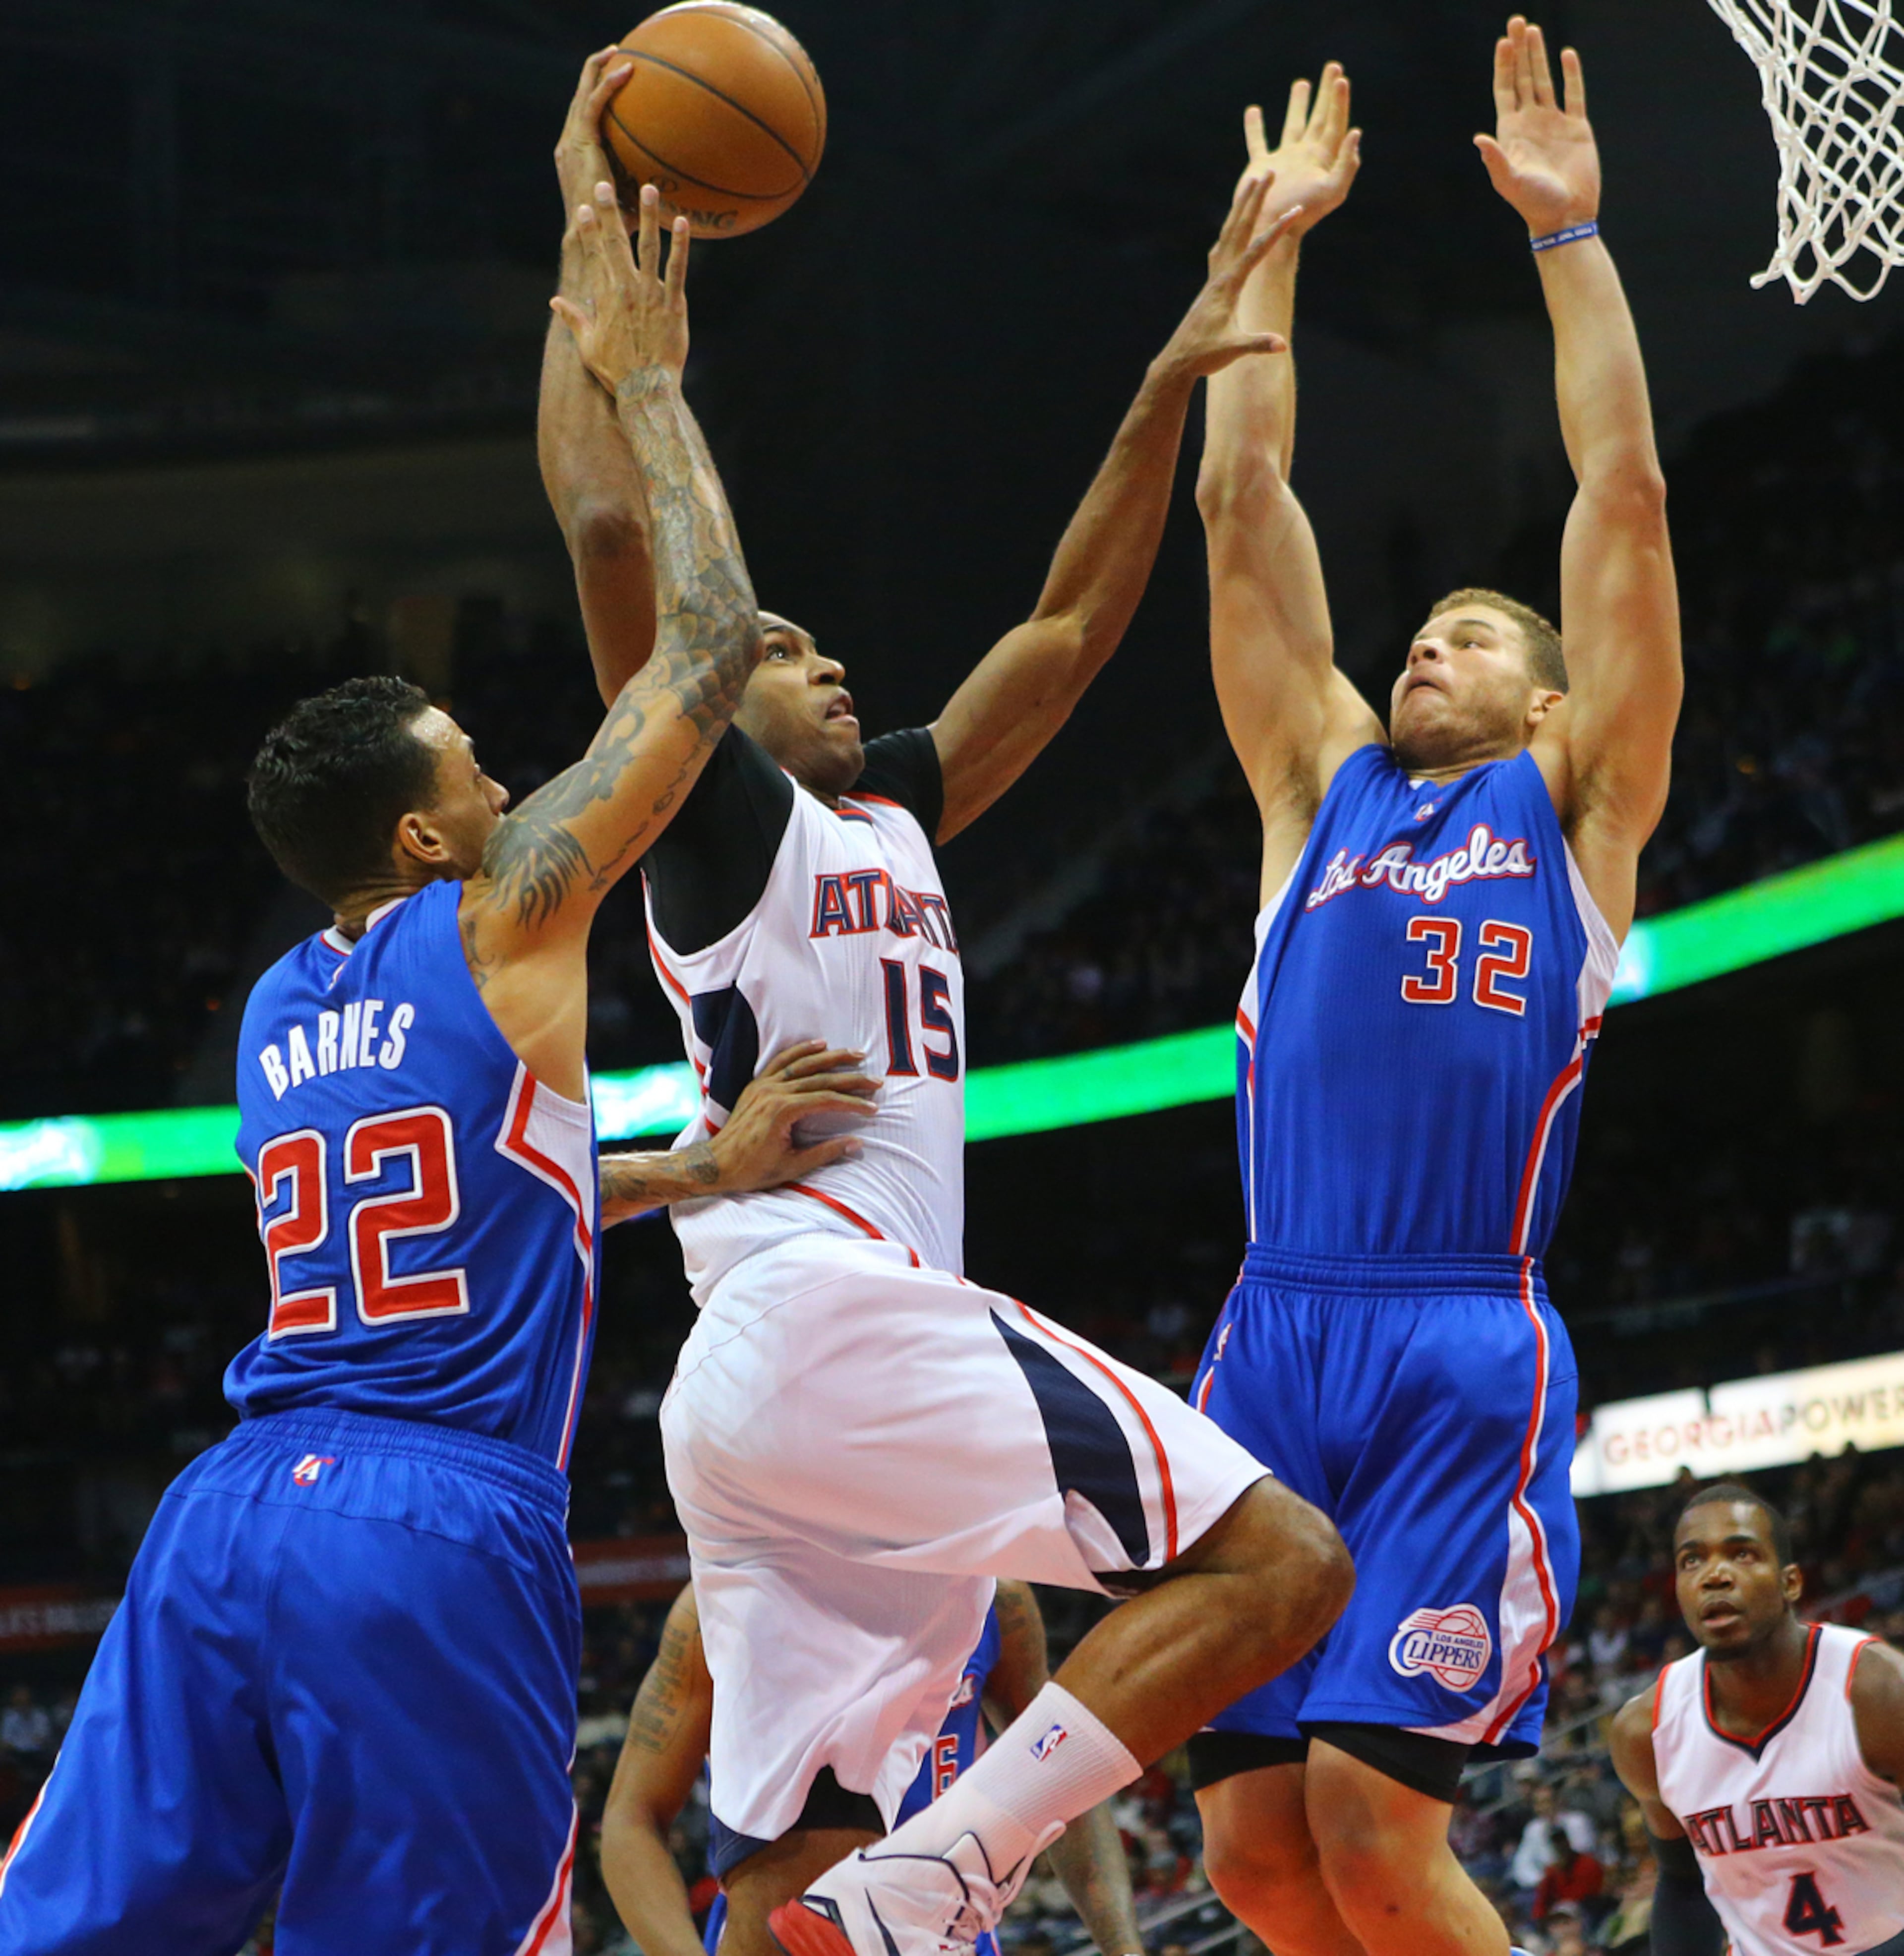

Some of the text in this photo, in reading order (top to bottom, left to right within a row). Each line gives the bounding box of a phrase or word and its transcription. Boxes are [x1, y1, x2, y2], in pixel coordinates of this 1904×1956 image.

[1305, 824, 1536, 912] Los Angeles
[1401, 916, 1533, 1016] 32
[259, 999, 415, 1101] BARNES
[880, 957, 958, 1083] 15
[258, 1105, 470, 1341] 22
[1396, 1630, 1483, 1670] CLIPPERS
[1683, 1793, 1872, 1857] ATLANTA
[1782, 1871, 1845, 1948] 4
